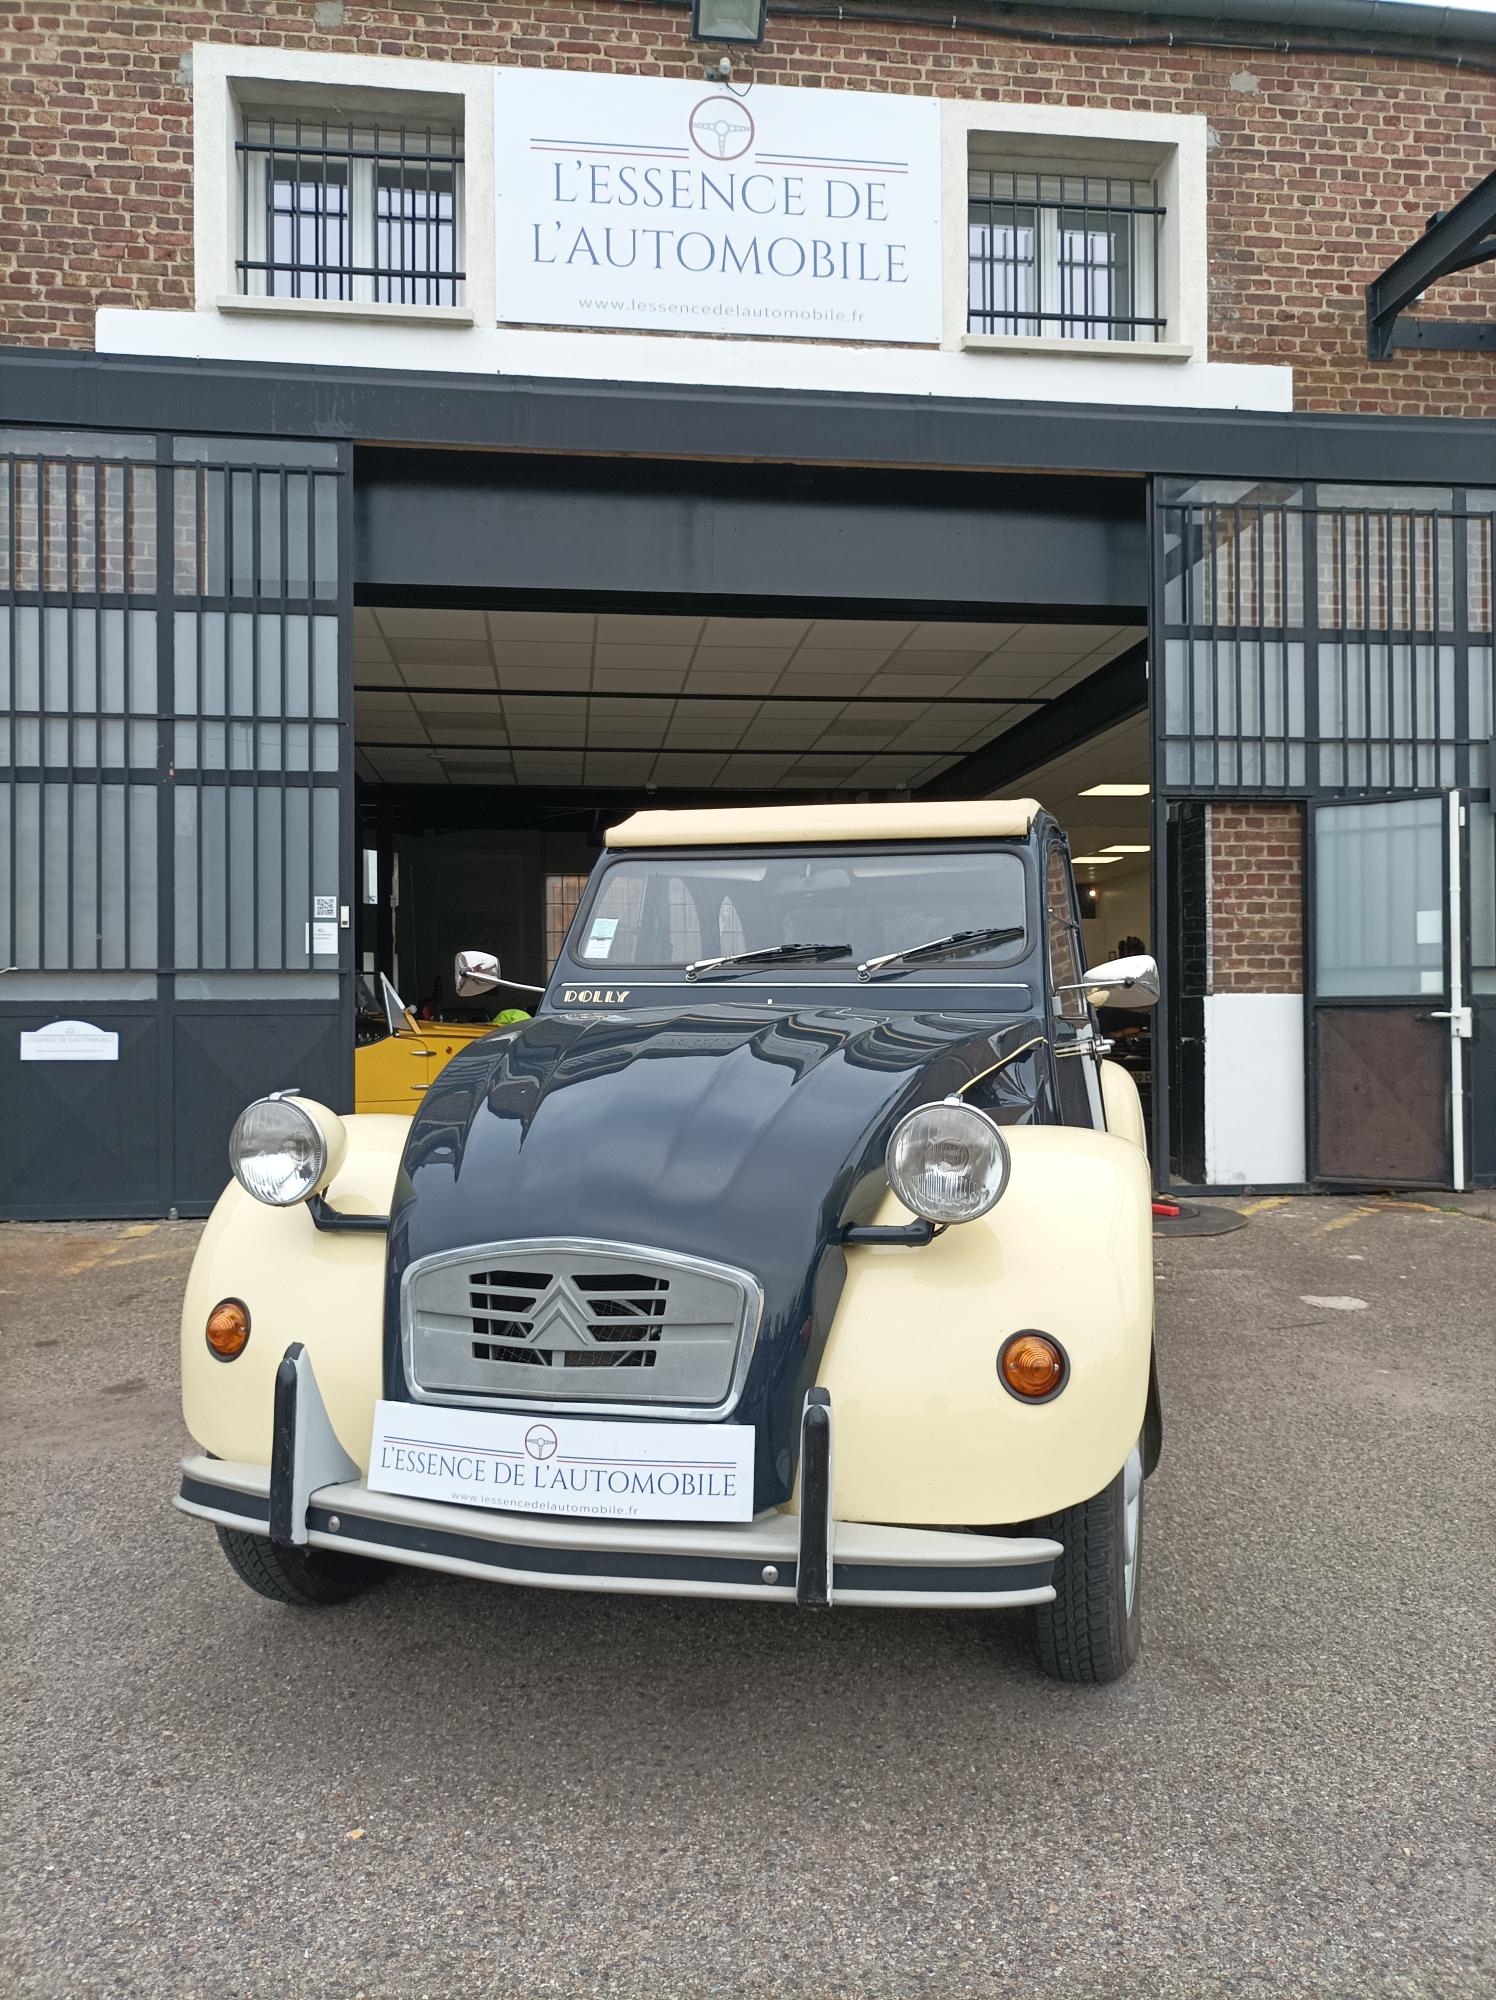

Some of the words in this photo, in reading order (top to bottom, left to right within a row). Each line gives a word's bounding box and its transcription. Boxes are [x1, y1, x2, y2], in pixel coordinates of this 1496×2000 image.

[553, 160, 806, 216] L'ESSENCE
[825, 180, 889, 221] DE
[532, 221, 910, 283] L'AUTOMOBILE
[578, 299, 865, 323] www.lessencedelautomobile.fr
[563, 990, 630, 1003] DOLLY
[380, 1447, 486, 1482] L'ESSENCE
[493, 1462, 526, 1487] DE
[534, 1465, 737, 1497] L'AUTOMOBILE
[451, 1491, 639, 1516] www.lessencedelautomobile.fr
